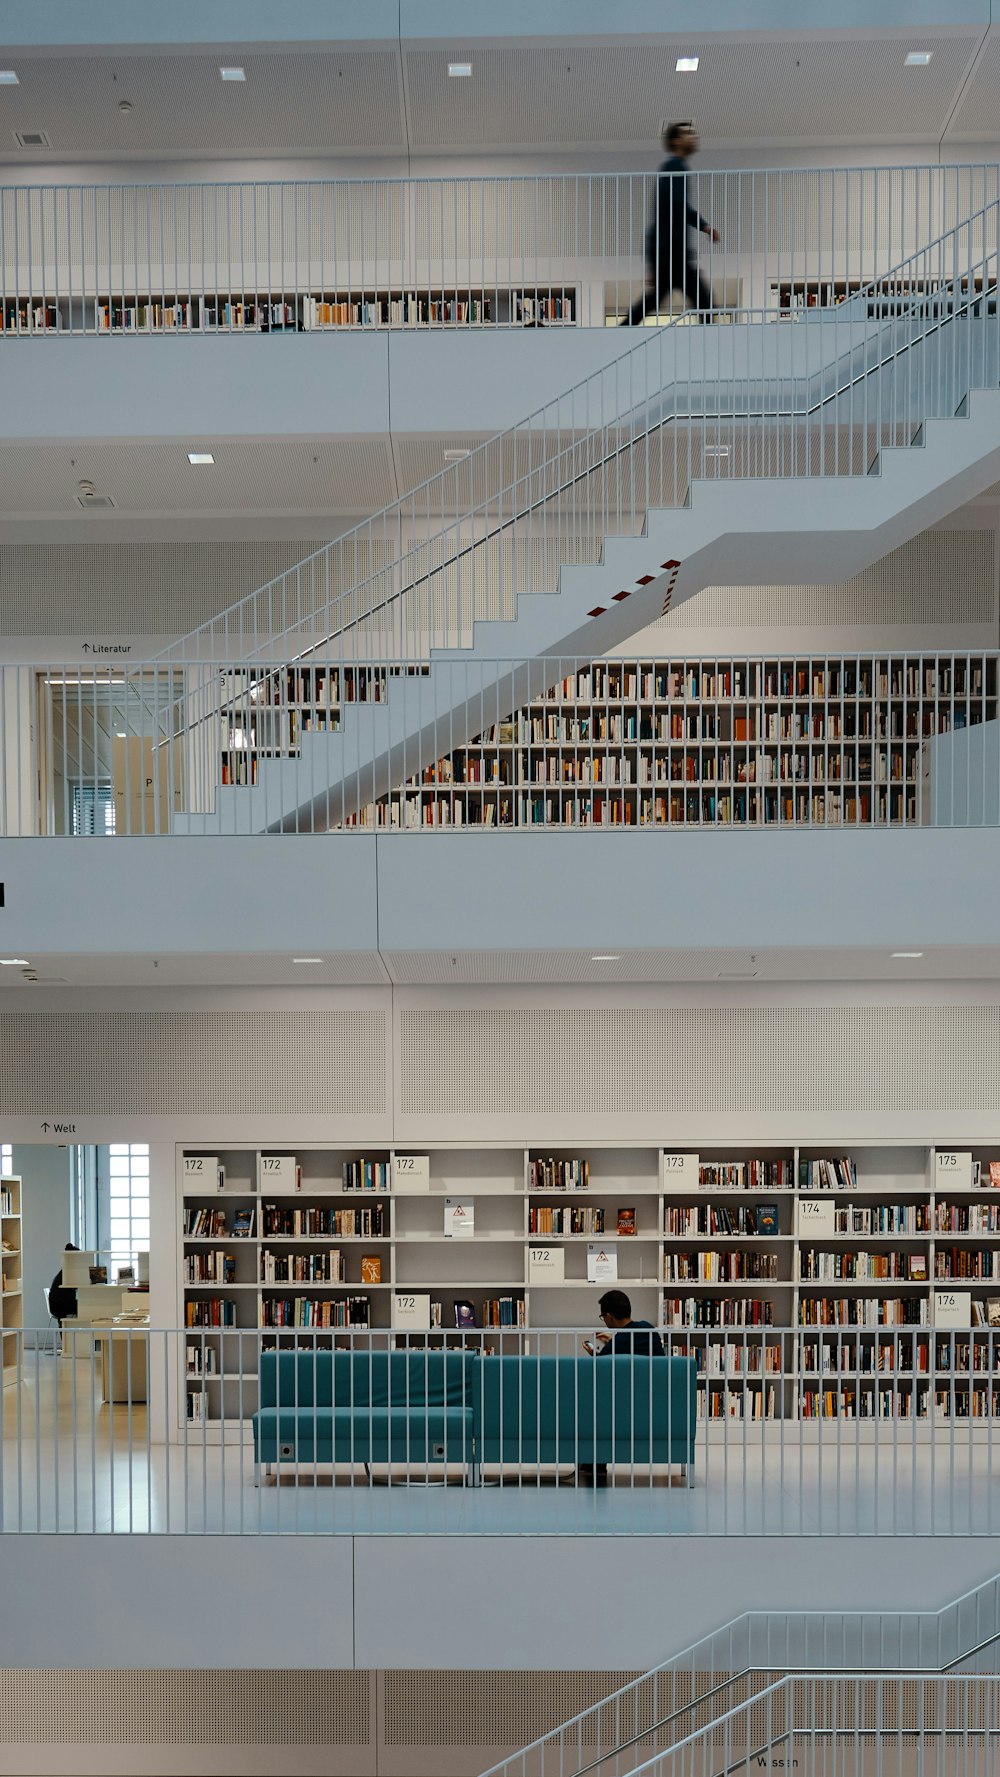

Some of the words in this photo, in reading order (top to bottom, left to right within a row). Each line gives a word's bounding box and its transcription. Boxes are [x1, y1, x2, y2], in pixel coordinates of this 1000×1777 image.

[92, 644, 131, 653] Literatur
[53, 1124, 76, 1133] Welt
[184, 1159, 203, 1170] 172
[262, 1159, 281, 1170] 172
[396, 1159, 415, 1169] 172
[666, 1157, 684, 1167] 173
[938, 1155, 957, 1165] 175
[801, 1203, 820, 1213] 174
[531, 1251, 550, 1261] 172
[397, 1297, 416, 1308] 172
[937, 1295, 955, 1305] 176
[757, 1757, 799, 1768] Wssn
